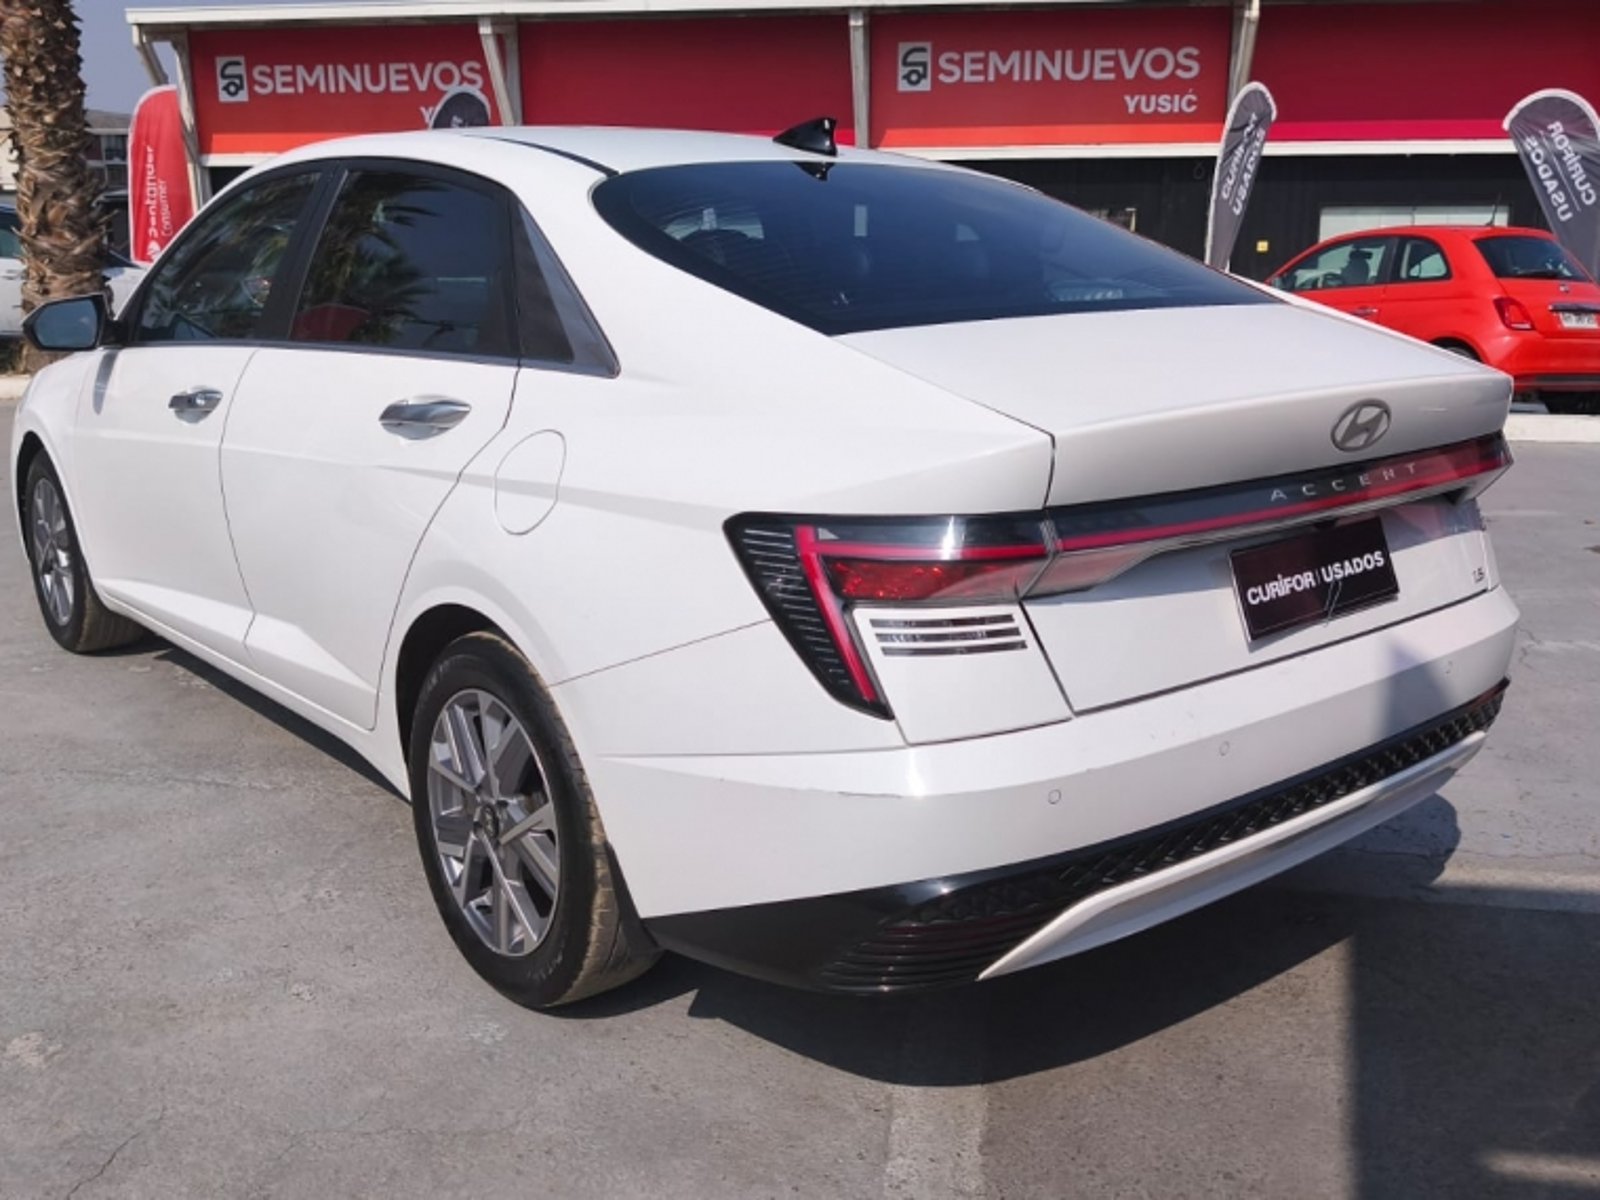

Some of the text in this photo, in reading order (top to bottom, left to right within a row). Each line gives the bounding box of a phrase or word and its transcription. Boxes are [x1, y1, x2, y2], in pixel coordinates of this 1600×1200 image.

[251, 61, 484, 95] SEMINUEVOS
[938, 47, 1201, 83] SEMINUEVOS
[1124, 88, 1198, 115] YUSIĆ
[158, 178, 173, 237] Consumer
[1270, 462, 1417, 501] ACCENT
[1321, 550, 1385, 583] USADOS
